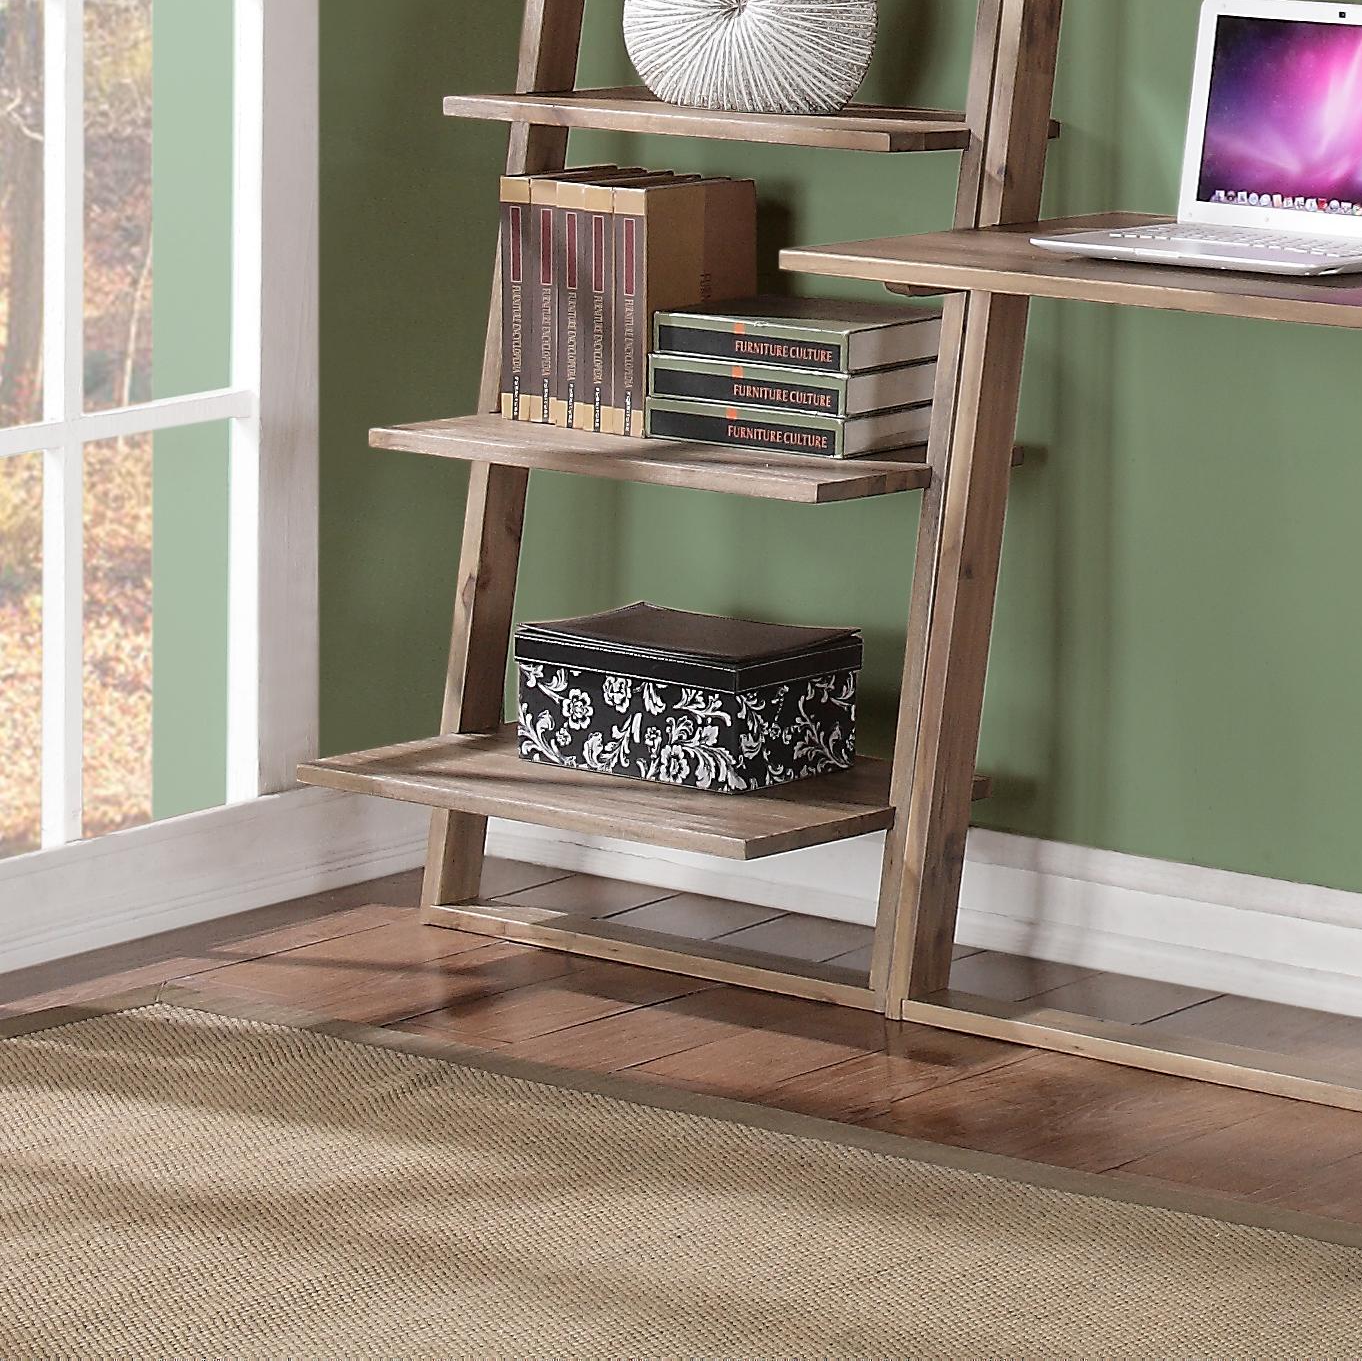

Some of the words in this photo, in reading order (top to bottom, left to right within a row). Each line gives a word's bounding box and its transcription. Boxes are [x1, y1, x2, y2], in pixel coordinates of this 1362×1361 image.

[735, 340, 788, 358] FURNITURE
[790, 346, 833, 363] CULTURE
[733, 384, 788, 402] FURNITURE
[790, 391, 831, 407] CULTURE
[728, 425, 782, 442] FURNITURE
[783, 431, 827, 448] CULTURE
